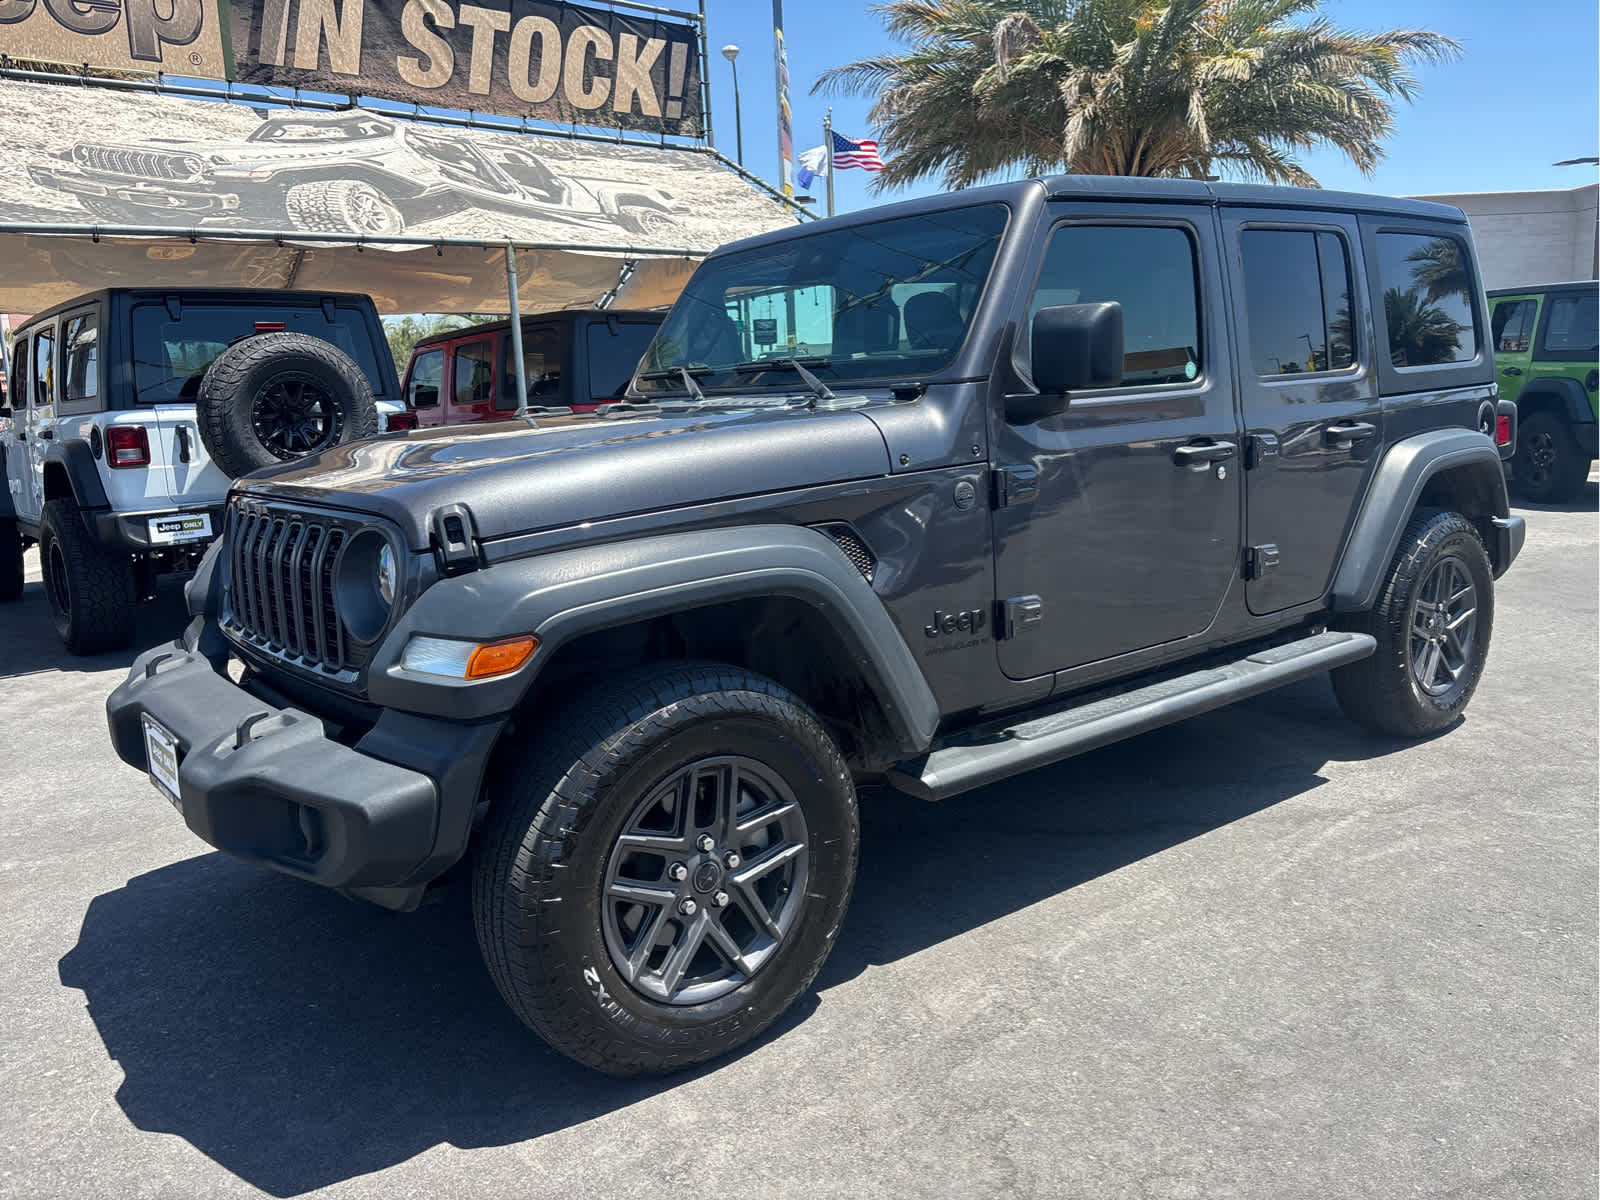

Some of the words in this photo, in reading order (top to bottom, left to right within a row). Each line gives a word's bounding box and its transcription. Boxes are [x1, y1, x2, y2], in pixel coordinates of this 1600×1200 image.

[259, 0, 365, 75] IN
[397, 0, 689, 120] STOCK!
[159, 523, 181, 532] Jeep
[183, 521, 203, 529] ONLY
[925, 609, 985, 637] Jeep
